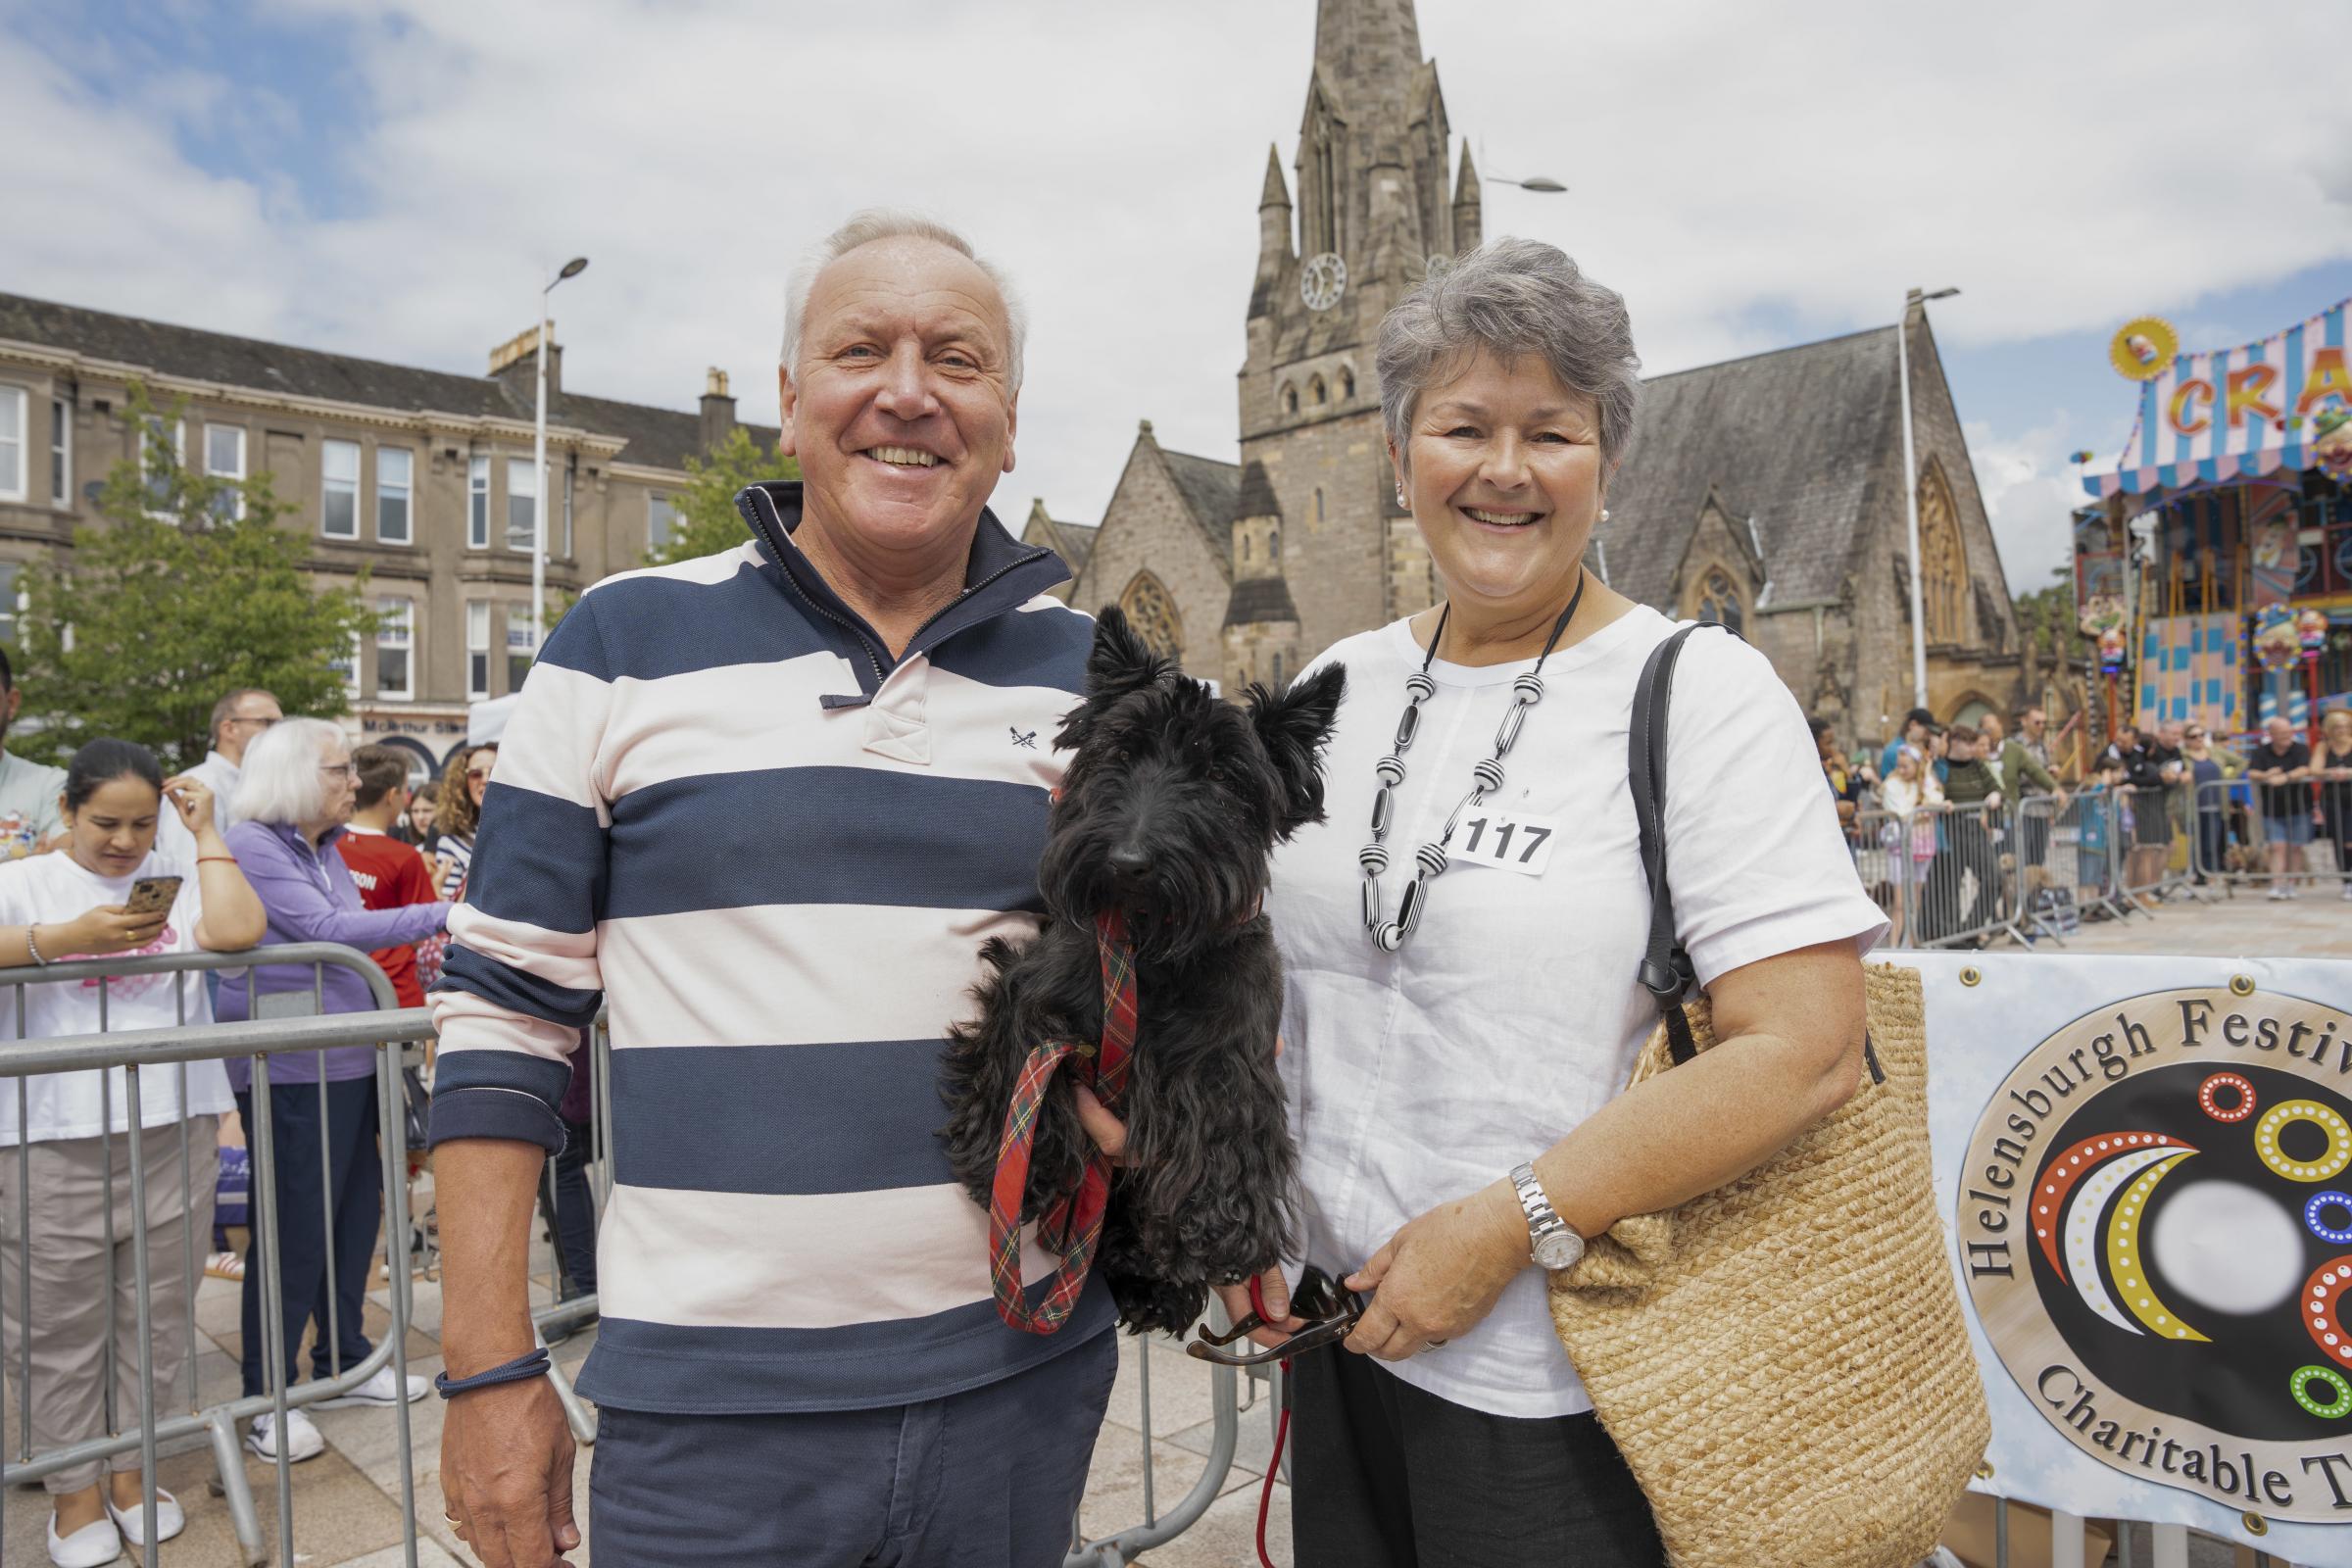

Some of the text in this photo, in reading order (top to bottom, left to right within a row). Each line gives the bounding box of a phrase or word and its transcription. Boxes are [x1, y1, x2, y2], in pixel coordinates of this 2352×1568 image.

[1465, 817, 1552, 863] 117
[1967, 1012, 2157, 1281] Helensburgh
[2036, 1364, 2292, 1507] Charitable
